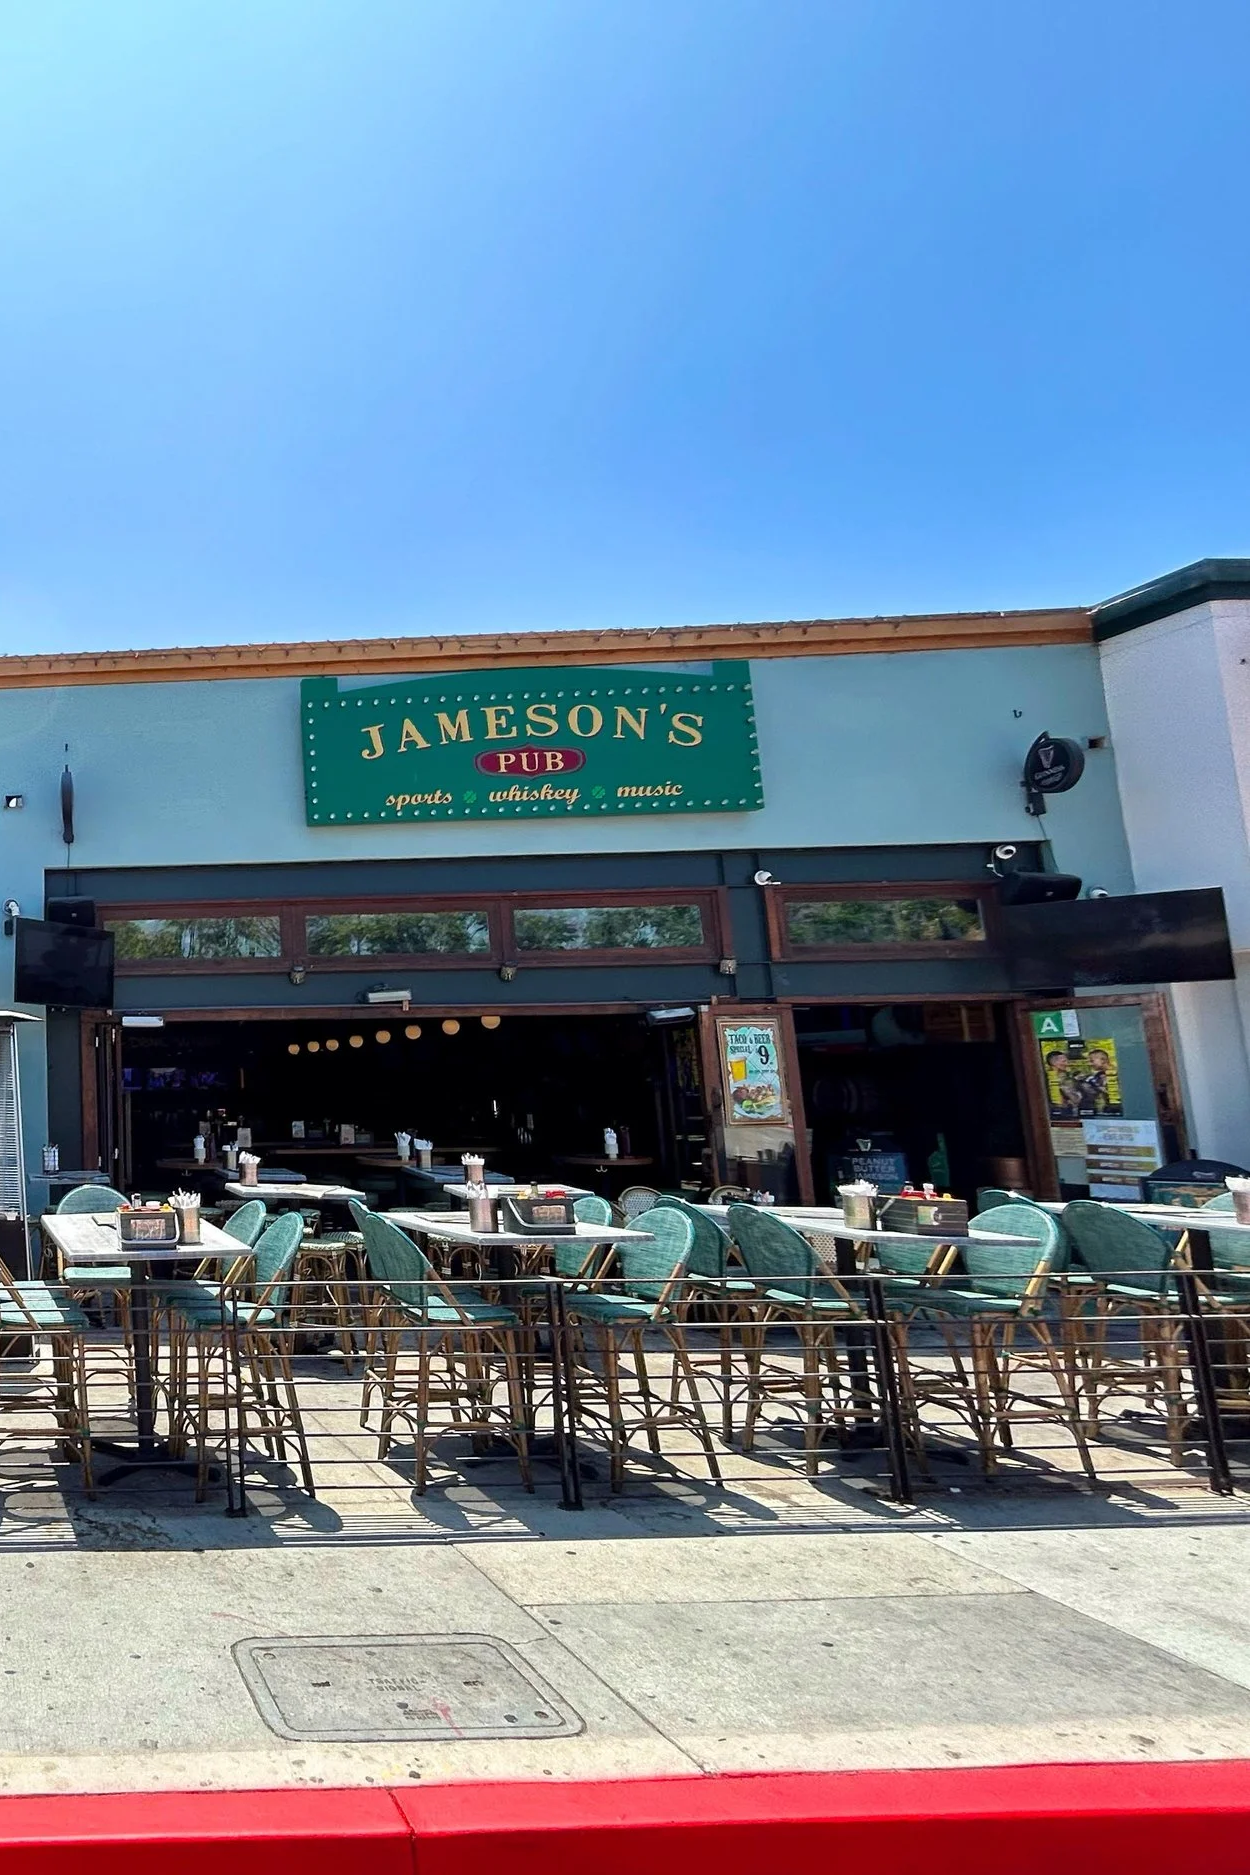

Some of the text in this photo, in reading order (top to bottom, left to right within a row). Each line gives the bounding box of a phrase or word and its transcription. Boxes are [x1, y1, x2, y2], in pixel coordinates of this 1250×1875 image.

[360, 703, 705, 760] JAMESON'S
[496, 750, 566, 774] PUB
[385, 781, 684, 809] sports whiskey music
[1040, 1018, 1059, 1033] A
